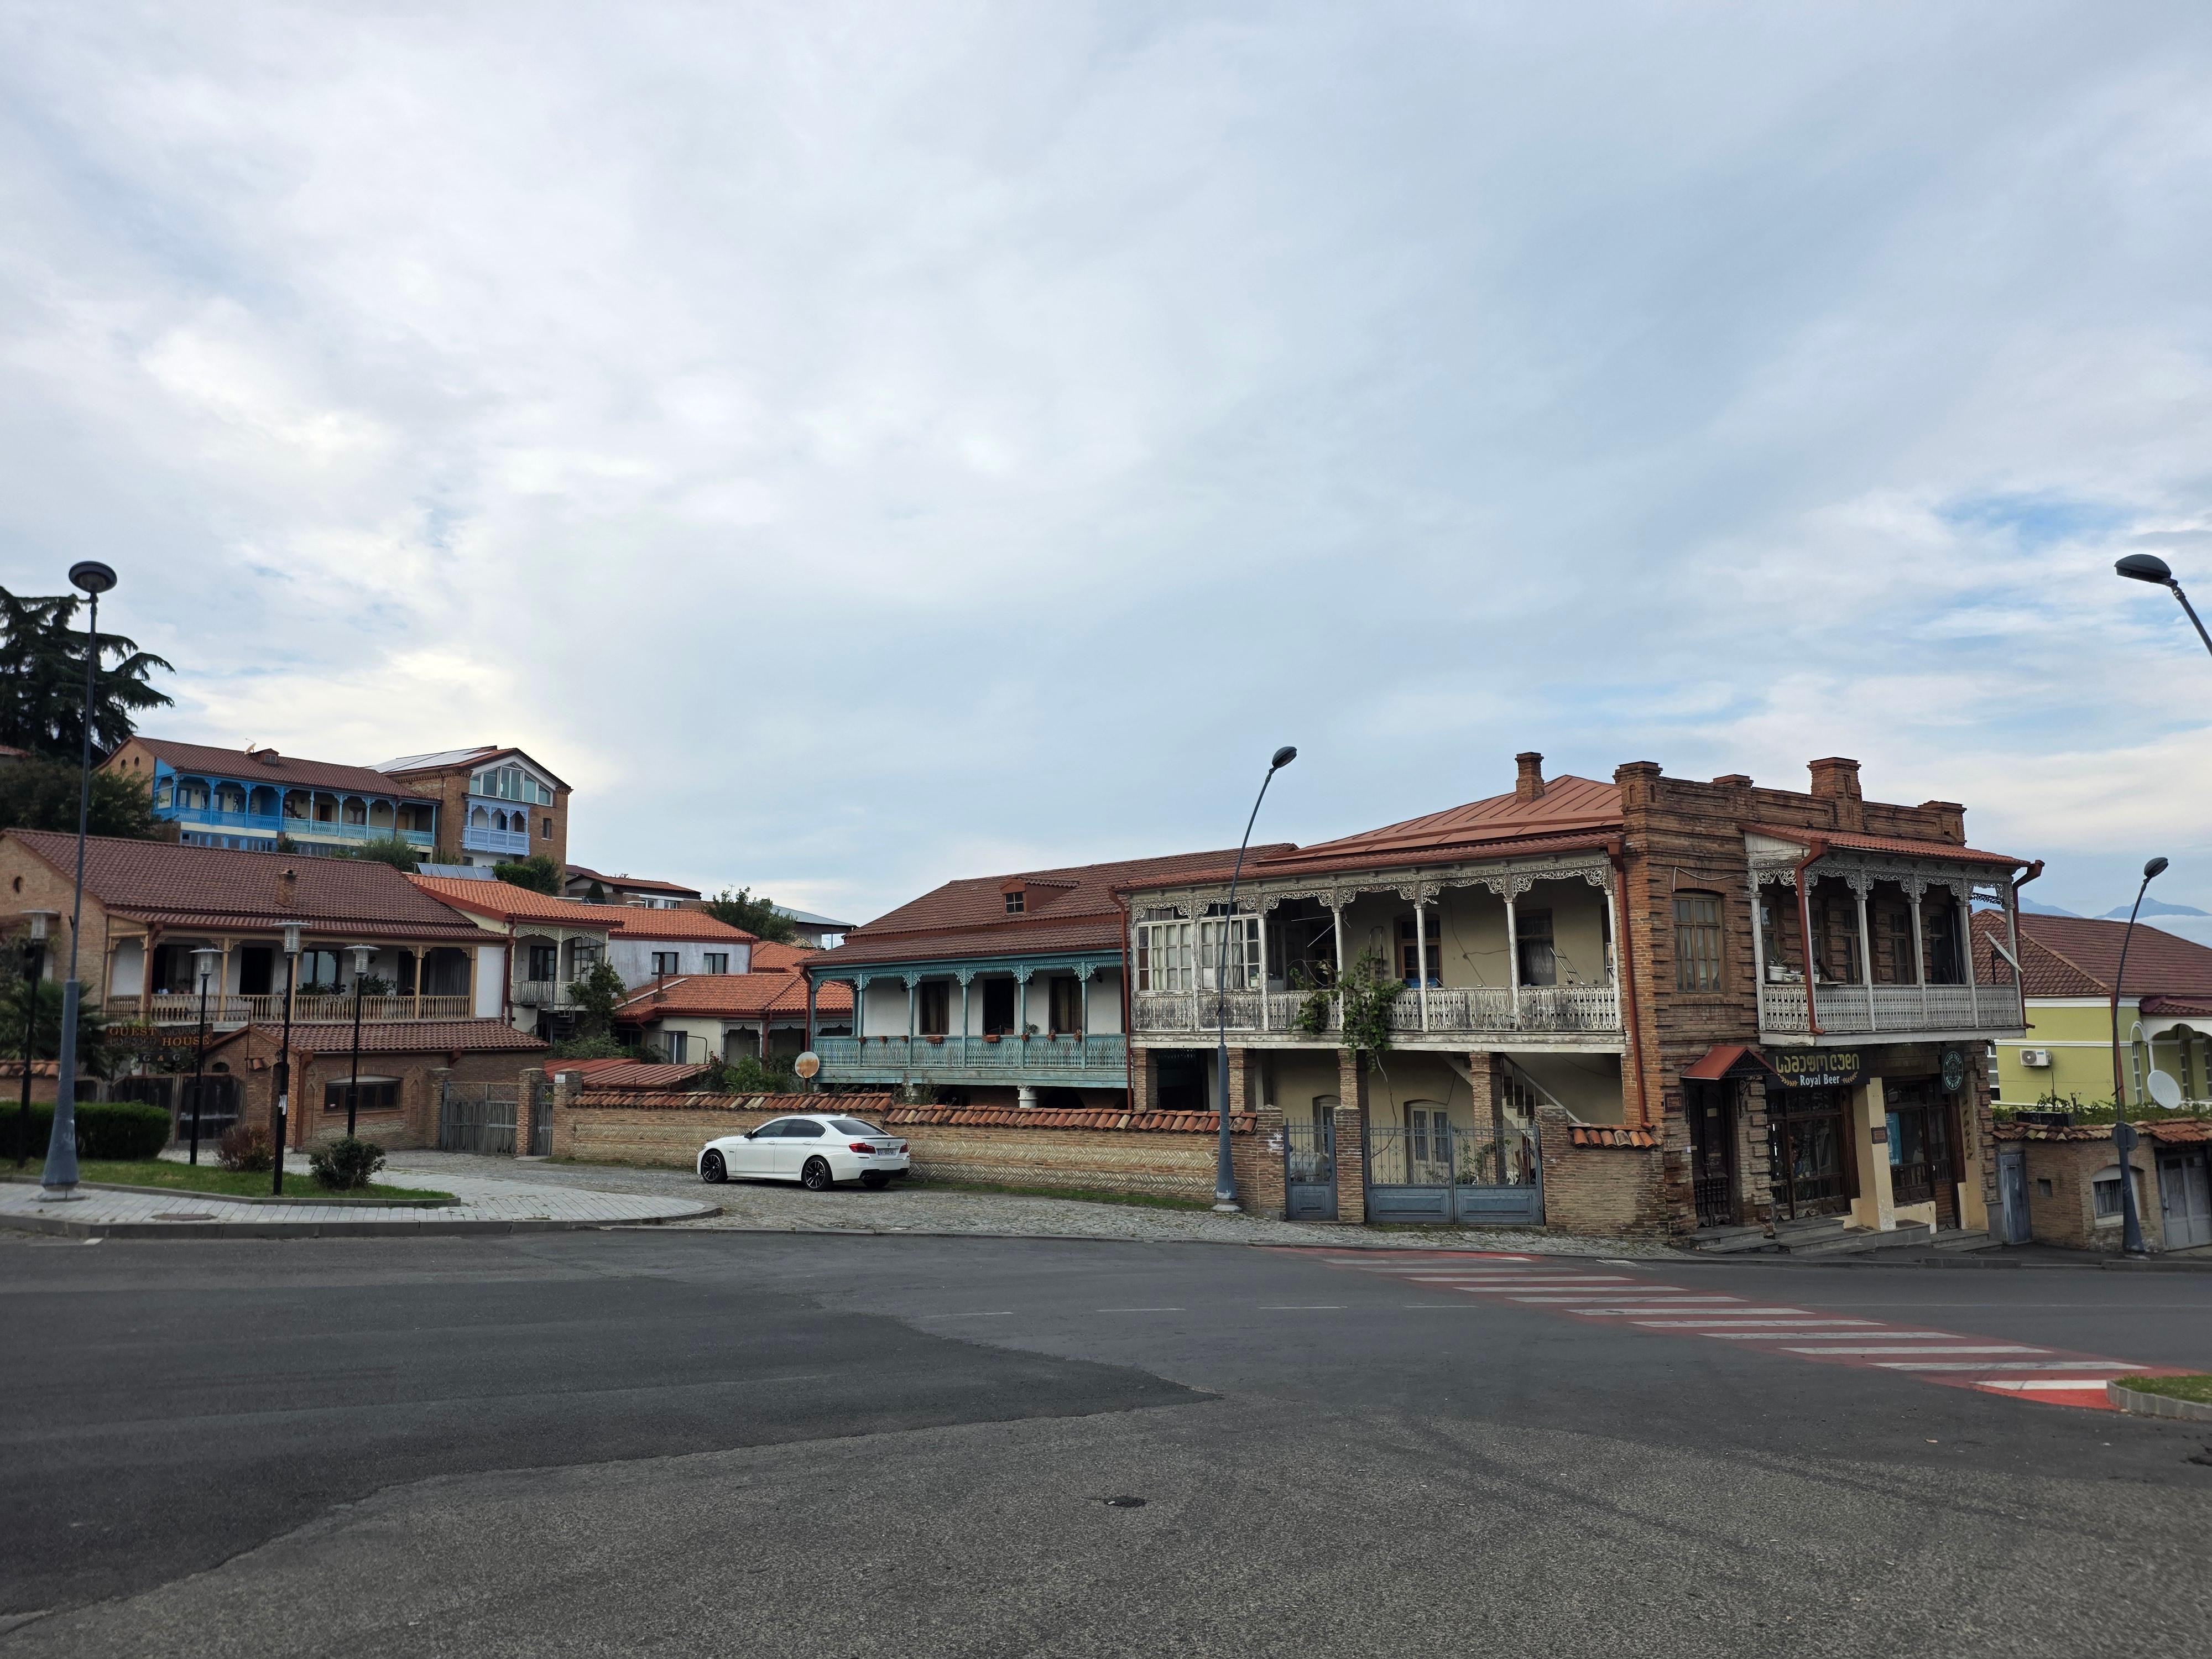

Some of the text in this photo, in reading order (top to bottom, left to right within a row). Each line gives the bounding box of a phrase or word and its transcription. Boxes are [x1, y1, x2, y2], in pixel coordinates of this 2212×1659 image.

[109, 1027, 157, 1036] GUEST
[162, 1035, 210, 1046] HOUSE
[1775, 1053, 1860, 1074] სამეფო ლუდი
[1799, 1074, 1840, 1088] Royal Beer
